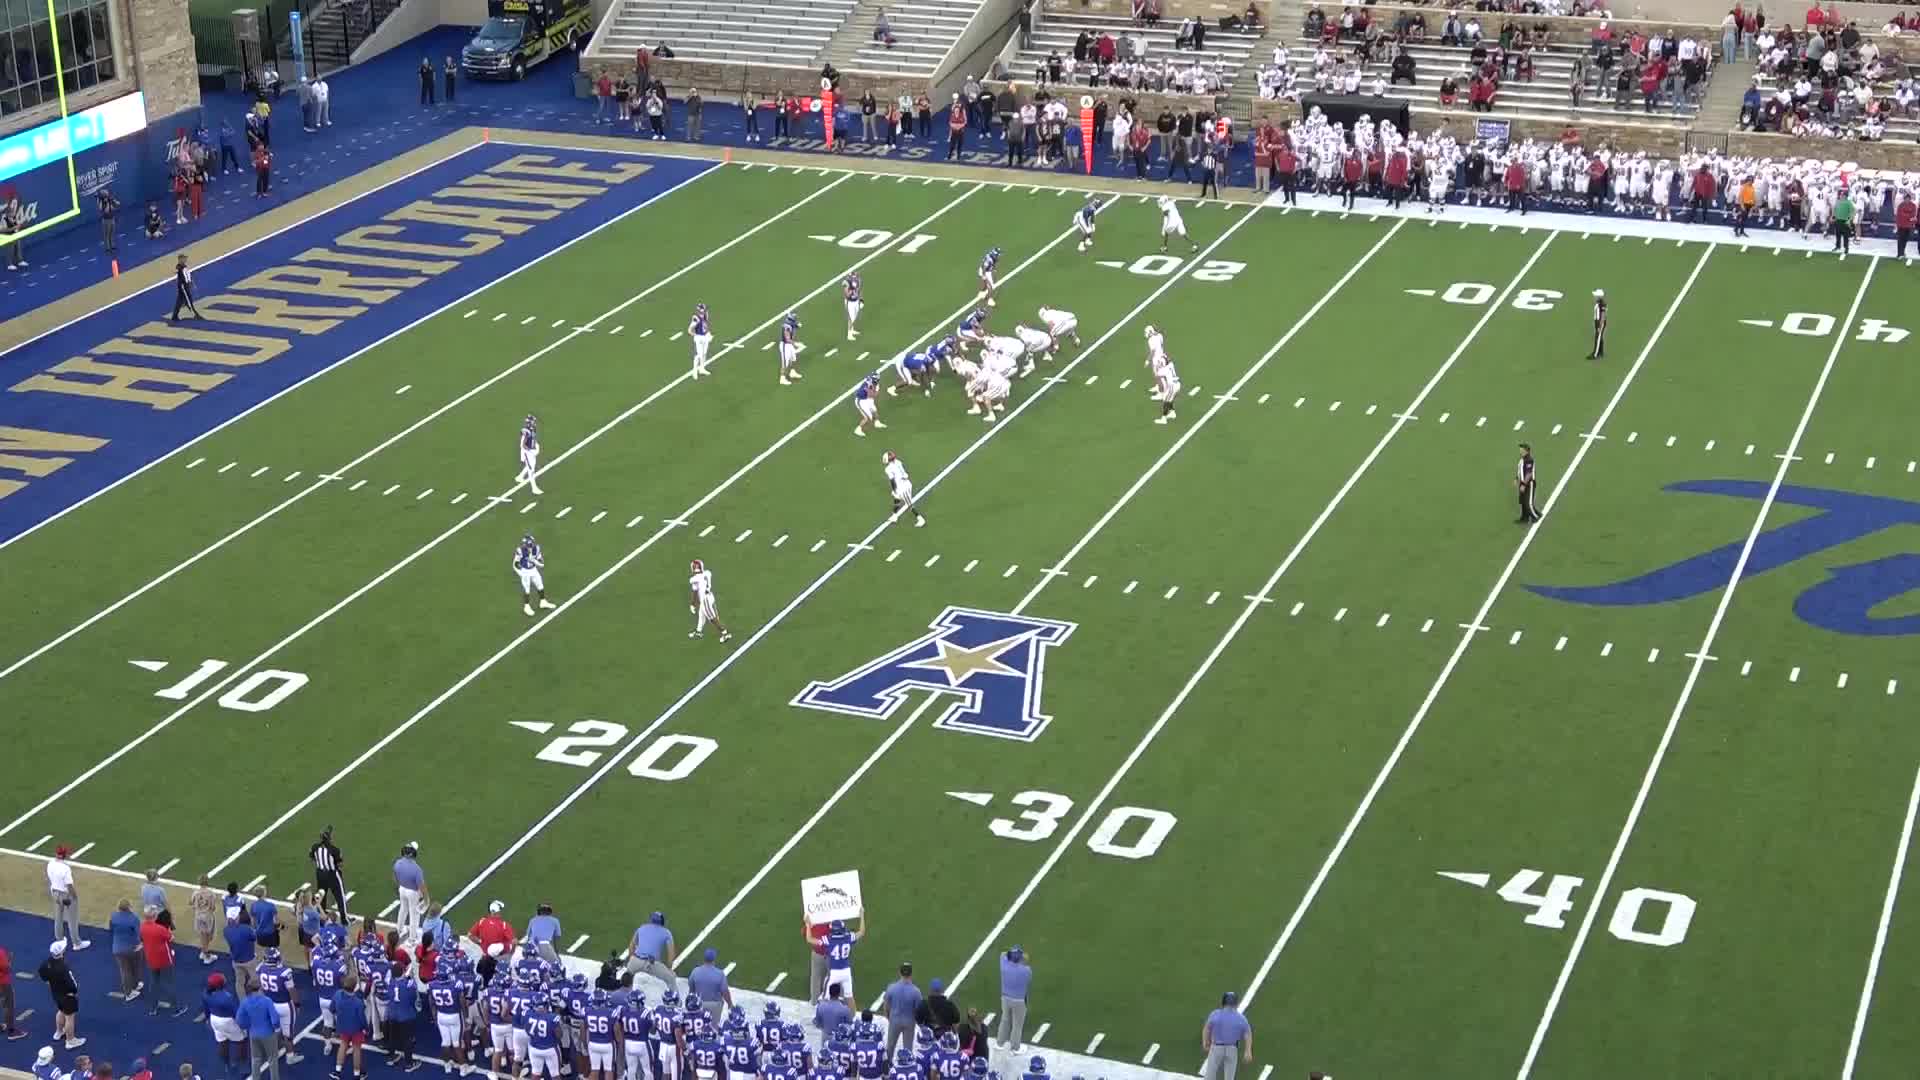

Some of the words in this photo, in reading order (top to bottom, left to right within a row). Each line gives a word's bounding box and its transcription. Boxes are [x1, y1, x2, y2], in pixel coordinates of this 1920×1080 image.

[838, 229, 936, 253] 10
[1128, 255, 1246, 280] 20
[8, 154, 654, 410] HURRICANE
[1442, 283, 1563, 310] 30
[1781, 312, 1910, 342] 40
[789, 606, 1079, 742] A
[154, 660, 308, 712] 10
[536, 719, 718, 780] 20
[989, 791, 1177, 859] 30
[1497, 869, 1697, 946] 40
[830, 943, 851, 960] 48
[260, 973, 279, 993] 65
[316, 968, 334, 987] 69
[432, 988, 454, 1007] 53
[528, 1017, 548, 1038] 79
[587, 1015, 609, 1034] 56
[622, 1016, 639, 1034] 10
[762, 1027, 780, 1044] 19
[696, 1049, 716, 1066] 32
[726, 1045, 749, 1065] 78
[857, 1050, 878, 1068] 27
[940, 1059, 961, 1078] 46
